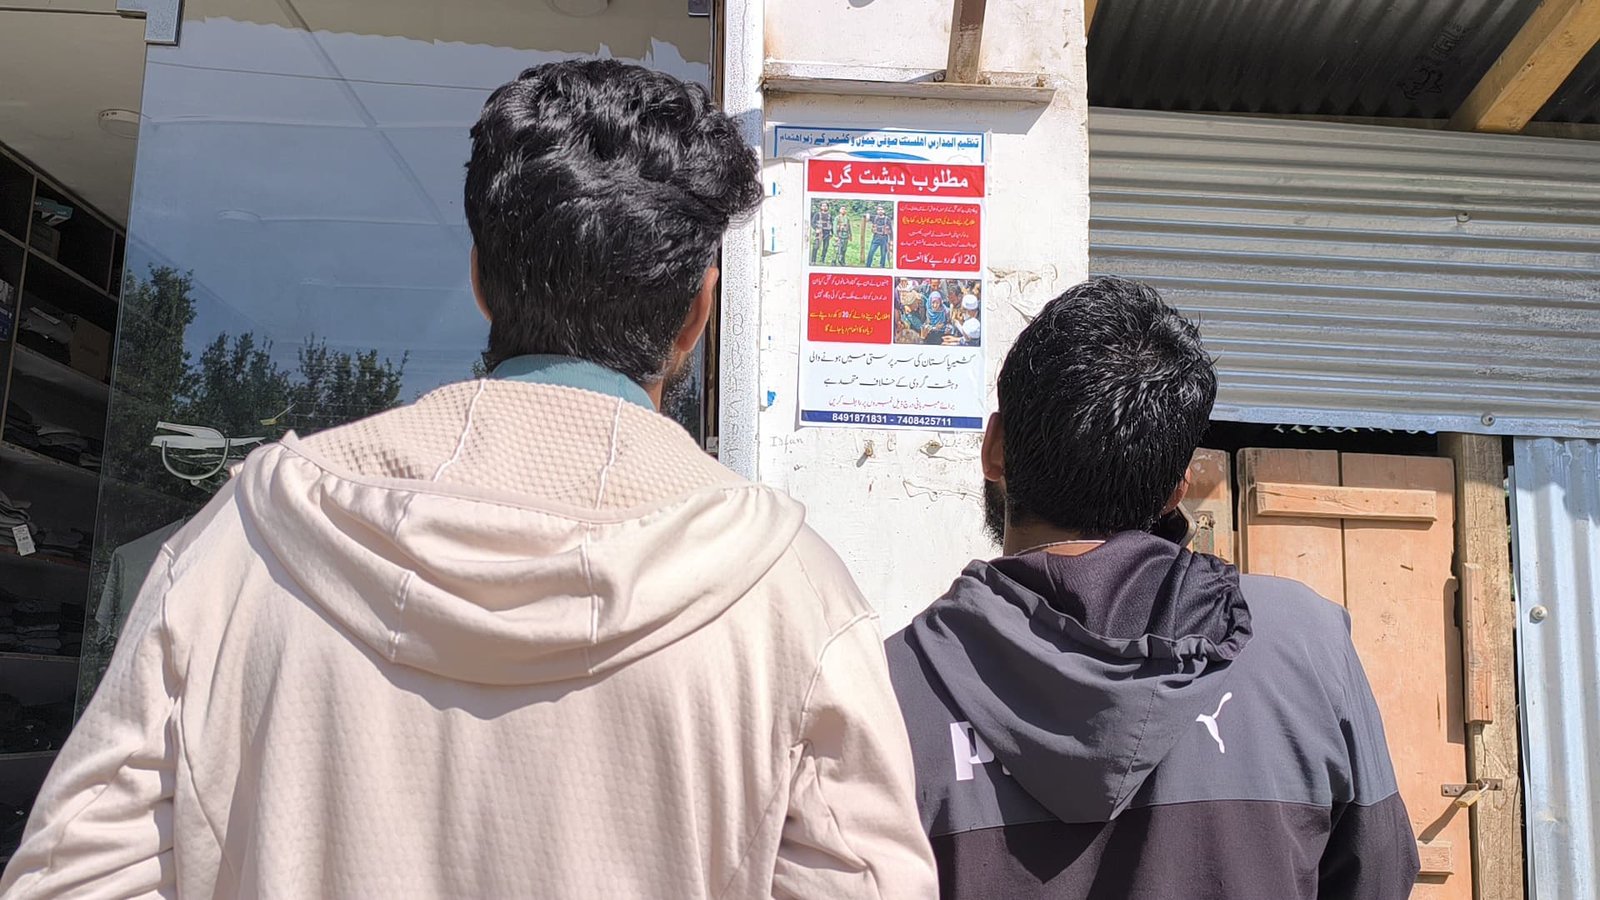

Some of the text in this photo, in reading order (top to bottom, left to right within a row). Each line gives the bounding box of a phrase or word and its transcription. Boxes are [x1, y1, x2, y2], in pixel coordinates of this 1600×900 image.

[824, 163, 969, 192] مطلوب دہشت گرد
[950, 251, 963, 265] لاکھ
[963, 254, 977, 265] 20
[808, 350, 820, 363] والی
[820, 351, 842, 363] ہونے
[841, 352, 866, 365] میں
[913, 352, 924, 368] کی
[921, 353, 951, 372] پاکستان
[859, 377, 896, 387] خلاف
[895, 375, 908, 388] کے
[926, 378, 959, 390] دہشت
[832, 412, 888, 424] 8491871831
[896, 415, 951, 427] 7408425711
